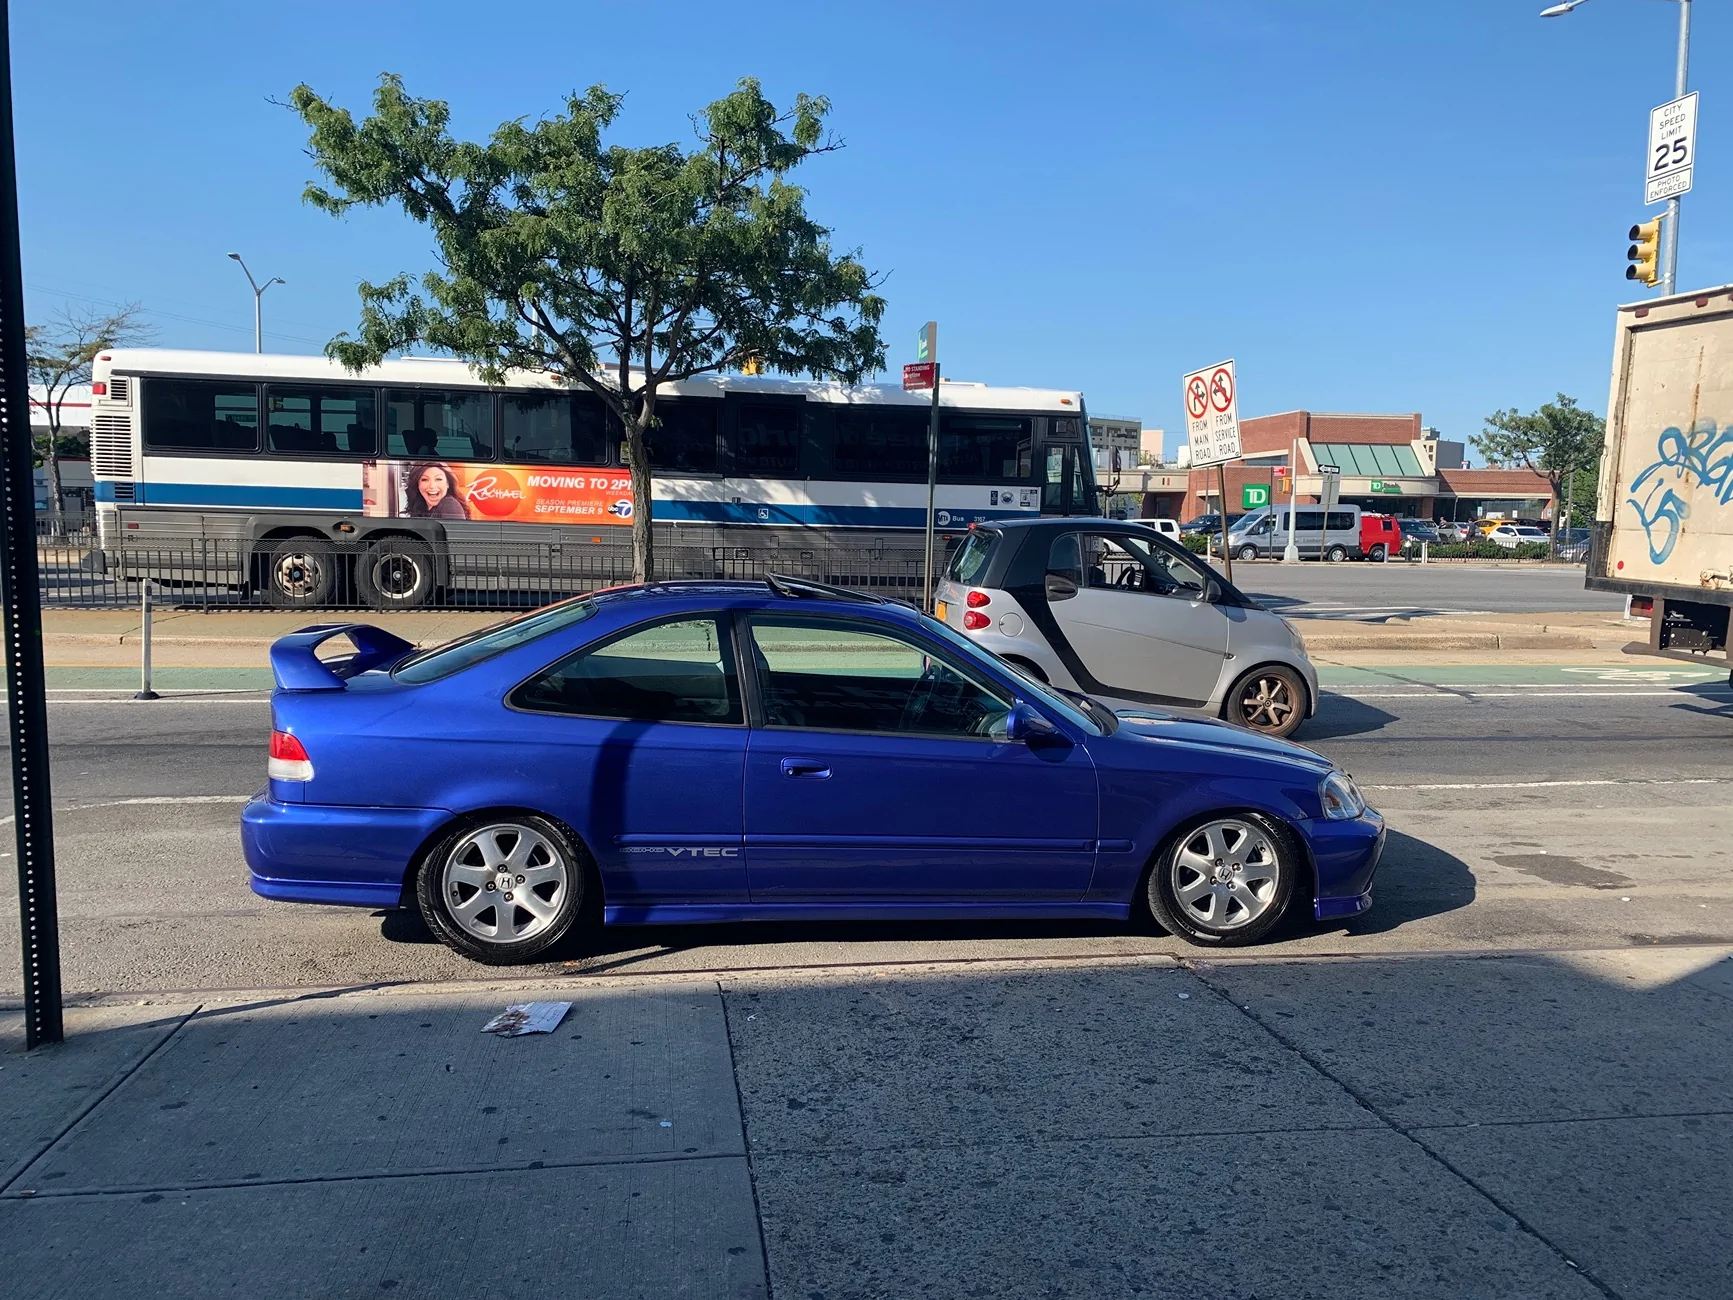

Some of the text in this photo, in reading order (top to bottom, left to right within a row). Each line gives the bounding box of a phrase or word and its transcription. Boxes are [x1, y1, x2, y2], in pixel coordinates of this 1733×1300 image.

[1664, 103, 1683, 117] CITY
[1659, 113, 1686, 130] SPEED
[1661, 125, 1682, 140] LIMIT
[1654, 136, 1688, 171] 25
[1657, 174, 1681, 188] PHOTO
[1650, 180, 1688, 199] ENFORCED
[1192, 420, 1208, 432] FROM
[1215, 412, 1233, 427] FROM
[1194, 433, 1209, 446] MAIN
[1214, 426, 1237, 442] SERVICE
[1195, 447, 1212, 460] ROAD
[1218, 442, 1236, 456] ROAD
[527, 475, 632, 491] MOVING TO 2P
[536, 498, 603, 508] SEASON PREMIERE
[1245, 488, 1266, 504] TD
[534, 504, 603, 515] SEPTEMBER 9
[666, 847, 738, 857] VTEC
